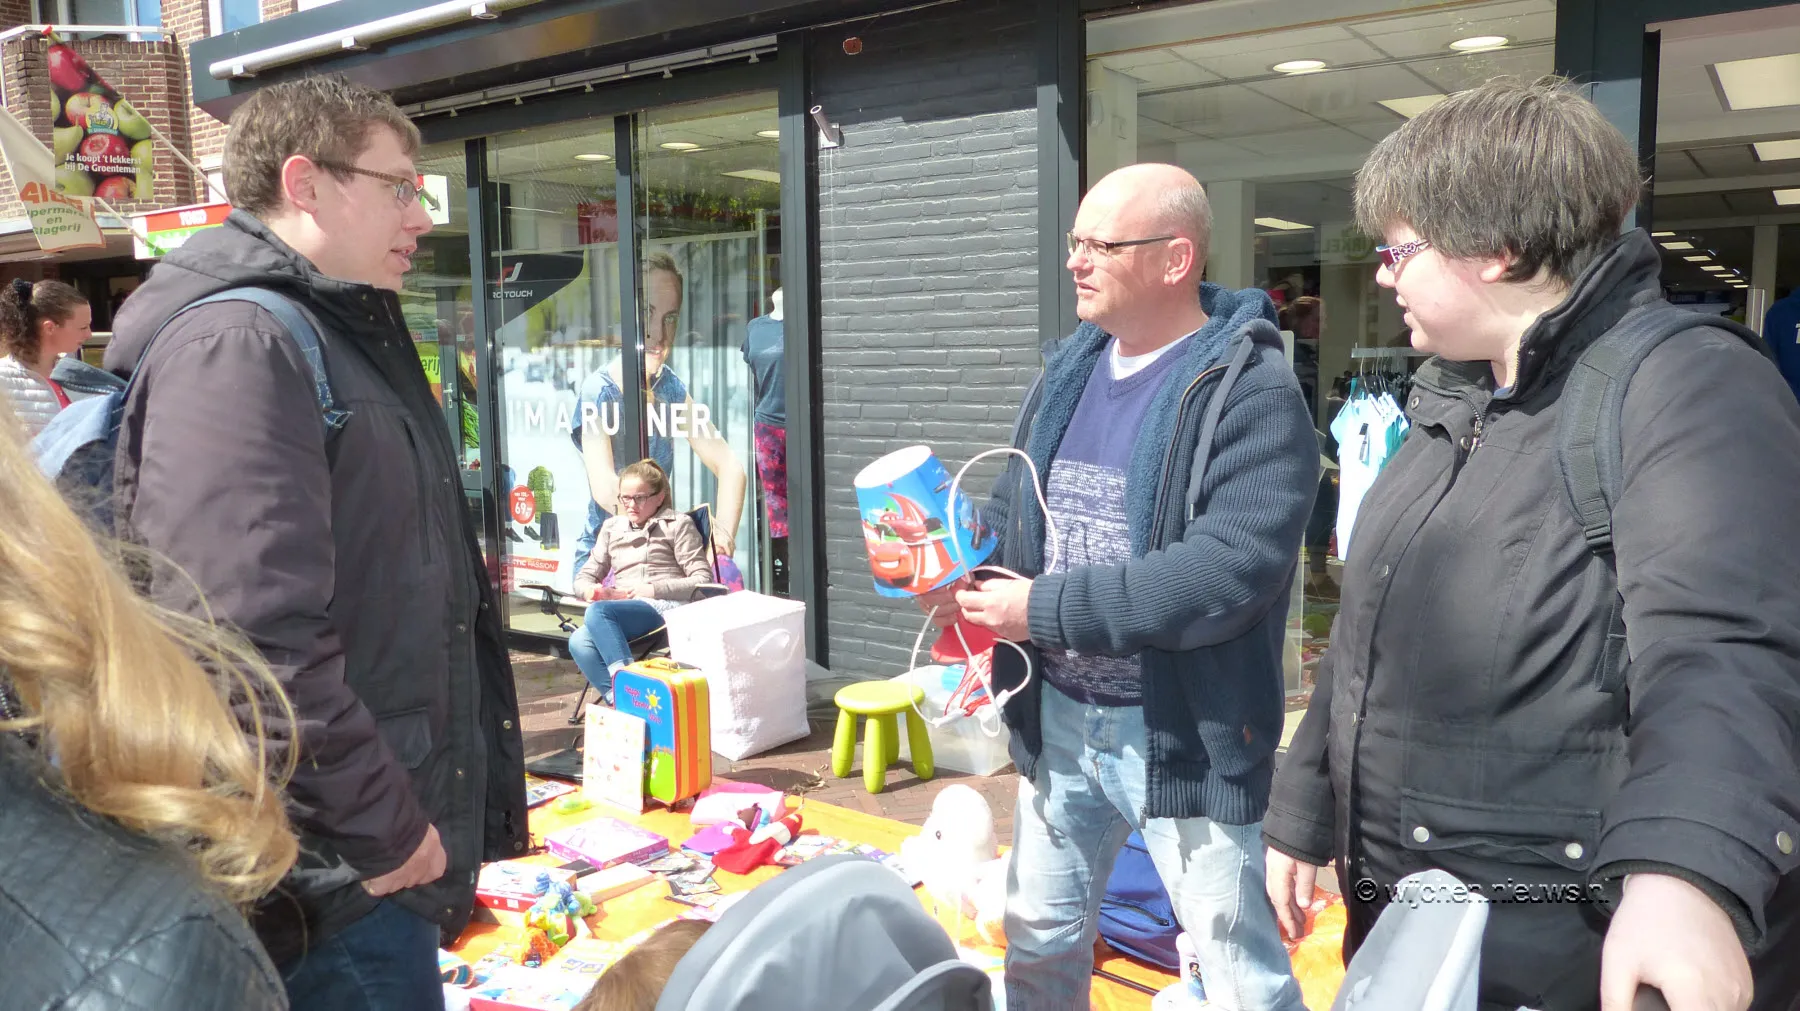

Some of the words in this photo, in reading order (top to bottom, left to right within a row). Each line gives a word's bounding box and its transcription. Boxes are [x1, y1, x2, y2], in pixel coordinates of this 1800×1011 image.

[65, 153, 75, 162] Je
[76, 153, 101, 163] koopt
[109, 154, 141, 165] lekkerst
[77, 163, 90, 172] De
[91, 163, 141, 174] Groenteman
[46, 216, 63, 225] en
[504, 289, 533, 299] TOUCH
[555, 401, 573, 434] A
